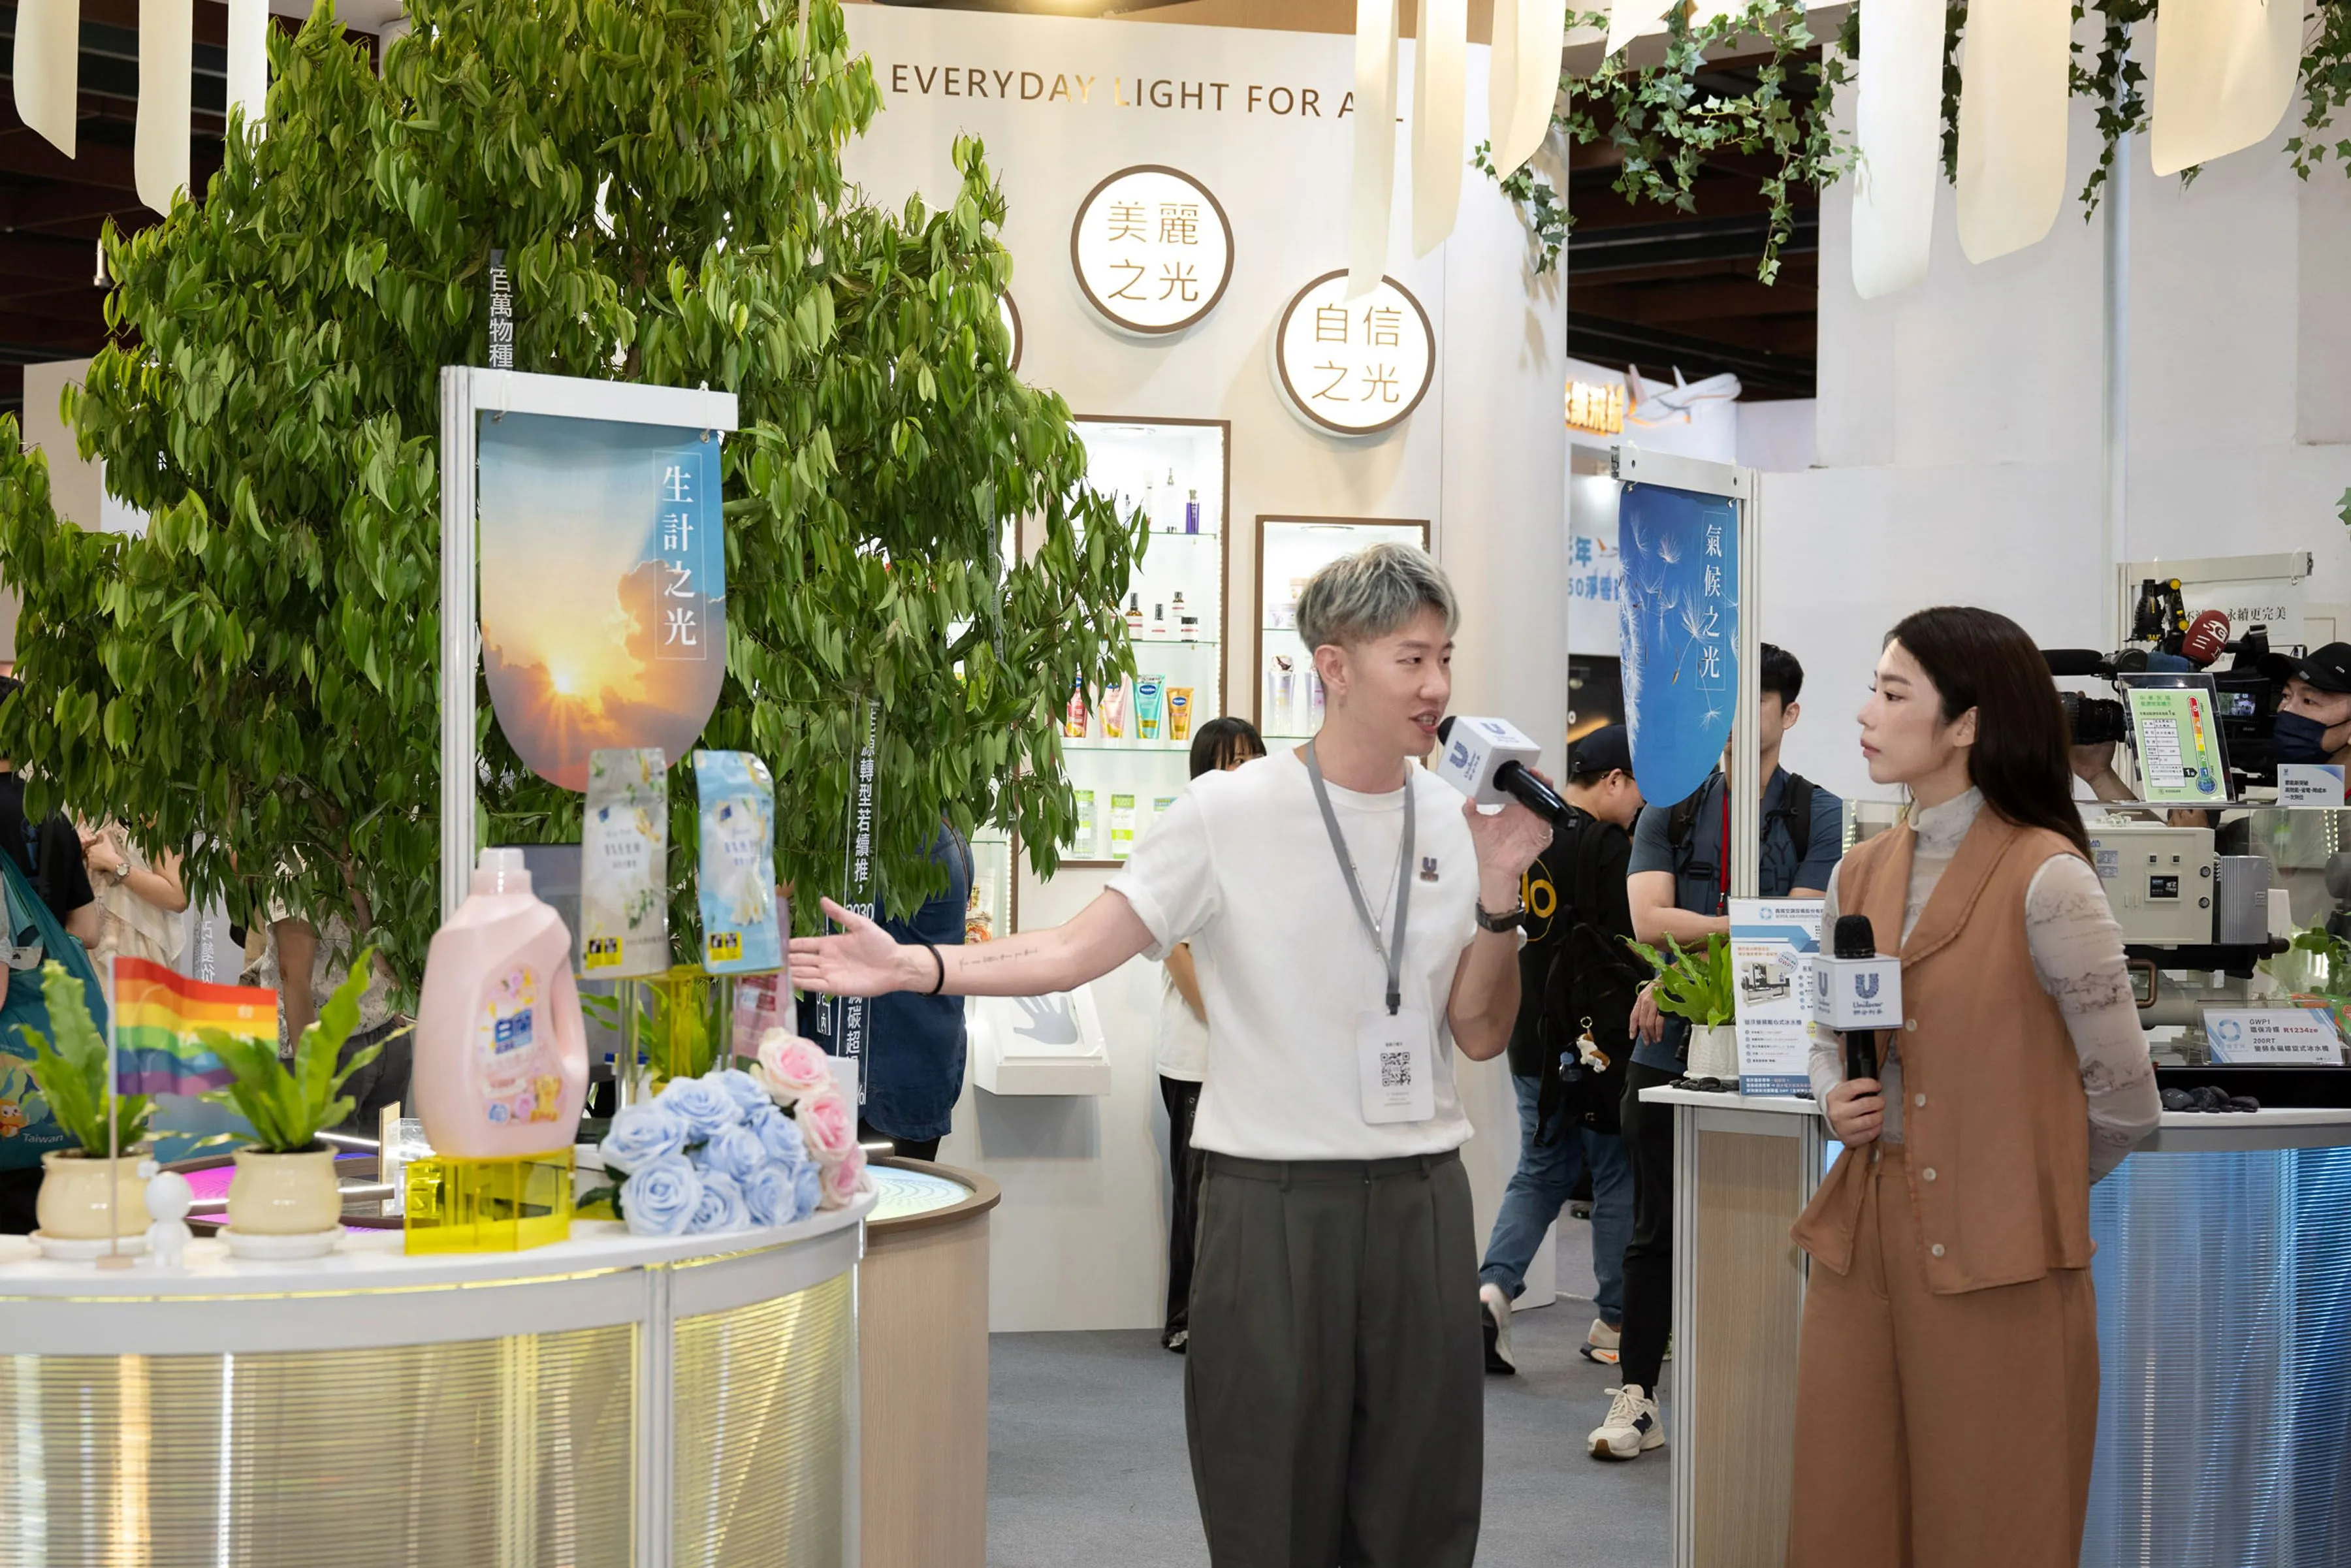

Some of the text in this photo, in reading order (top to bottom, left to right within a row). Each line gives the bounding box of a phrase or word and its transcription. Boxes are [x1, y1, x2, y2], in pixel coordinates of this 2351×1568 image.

[891, 63, 1096, 105] EVERYDAY
[1113, 76, 1230, 111] LIGHT
[1247, 84, 1322, 118] FOR
[1107, 200, 1200, 246] 美麗
[1107, 259, 1199, 302] 之光
[1316, 302, 1402, 347] 自信
[1311, 360, 1400, 403] 之光
[662, 465, 697, 647] 生計之光
[1701, 523, 1723, 679] 氣候之光
[2228, 605, 2287, 622] 永續更完美
[22, 1132, 64, 1144] Taiwan
